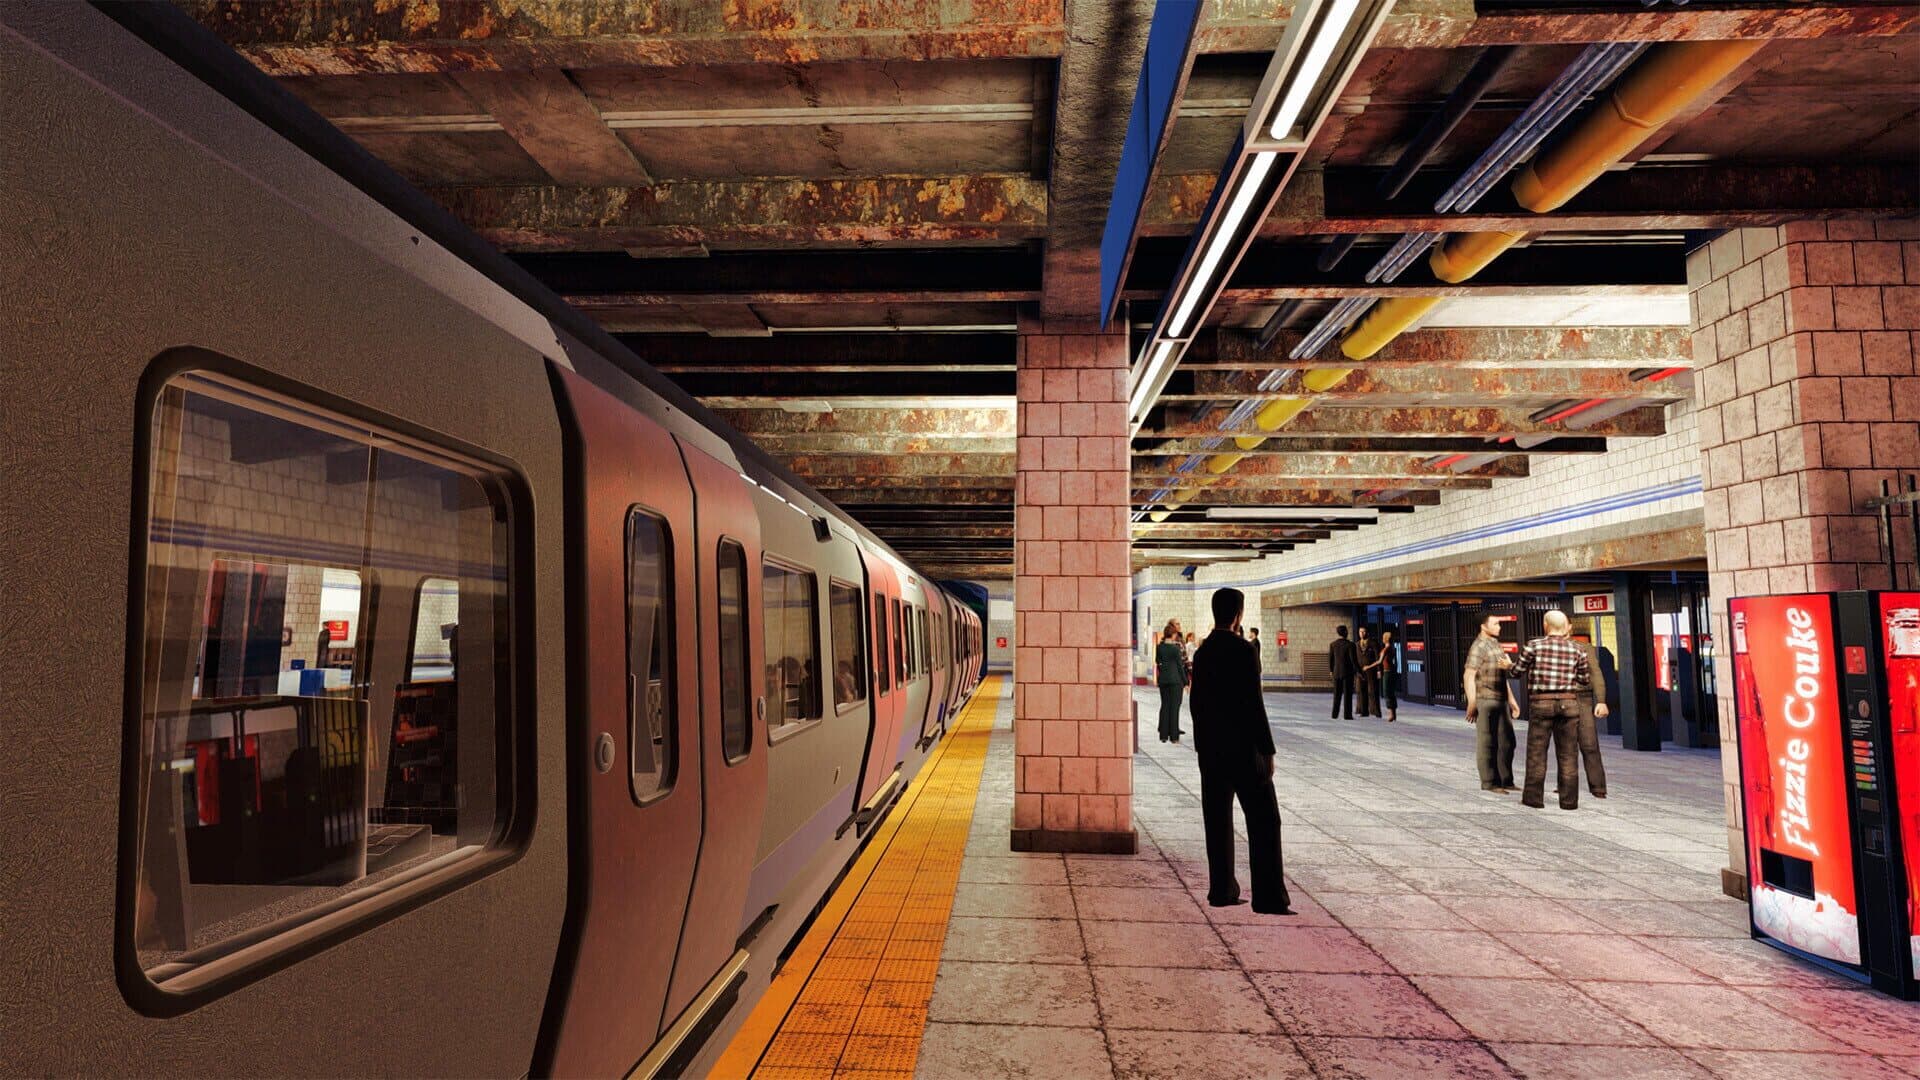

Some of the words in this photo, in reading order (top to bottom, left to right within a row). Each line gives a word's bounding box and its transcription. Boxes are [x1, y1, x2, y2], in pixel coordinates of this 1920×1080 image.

[1586, 598, 1604, 610] Exit
[1784, 607, 1821, 729] Couke
[1779, 738, 1820, 857] Fizzie
